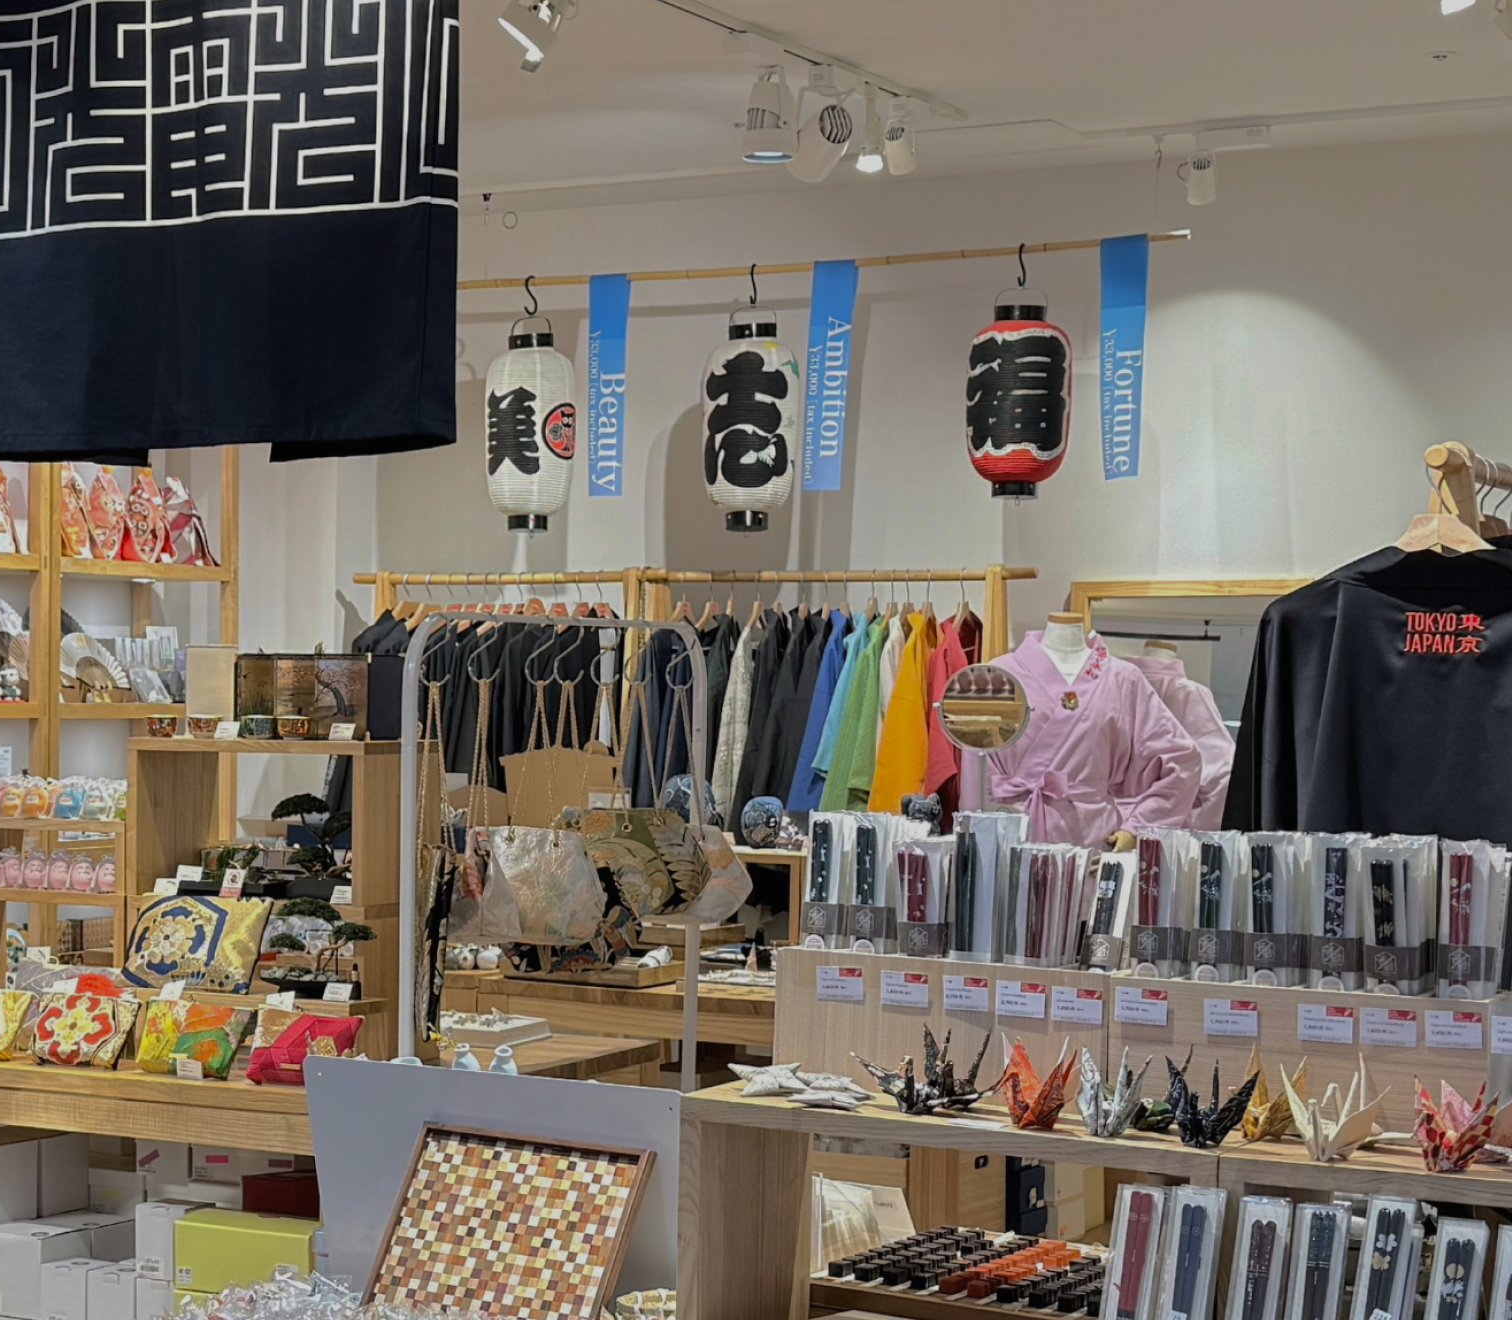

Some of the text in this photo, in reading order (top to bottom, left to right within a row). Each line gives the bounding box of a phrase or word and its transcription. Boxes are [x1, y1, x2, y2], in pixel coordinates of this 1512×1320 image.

[488, 386, 540, 476] 美
[591, 372, 626, 493] Beauty
[819, 316, 852, 458] Ambition
[966, 332, 1068, 456] 福
[1113, 349, 1142, 473] Fortune
[1403, 633, 1455, 653] JAPAN
[1405, 611, 1457, 633] TOKYO
